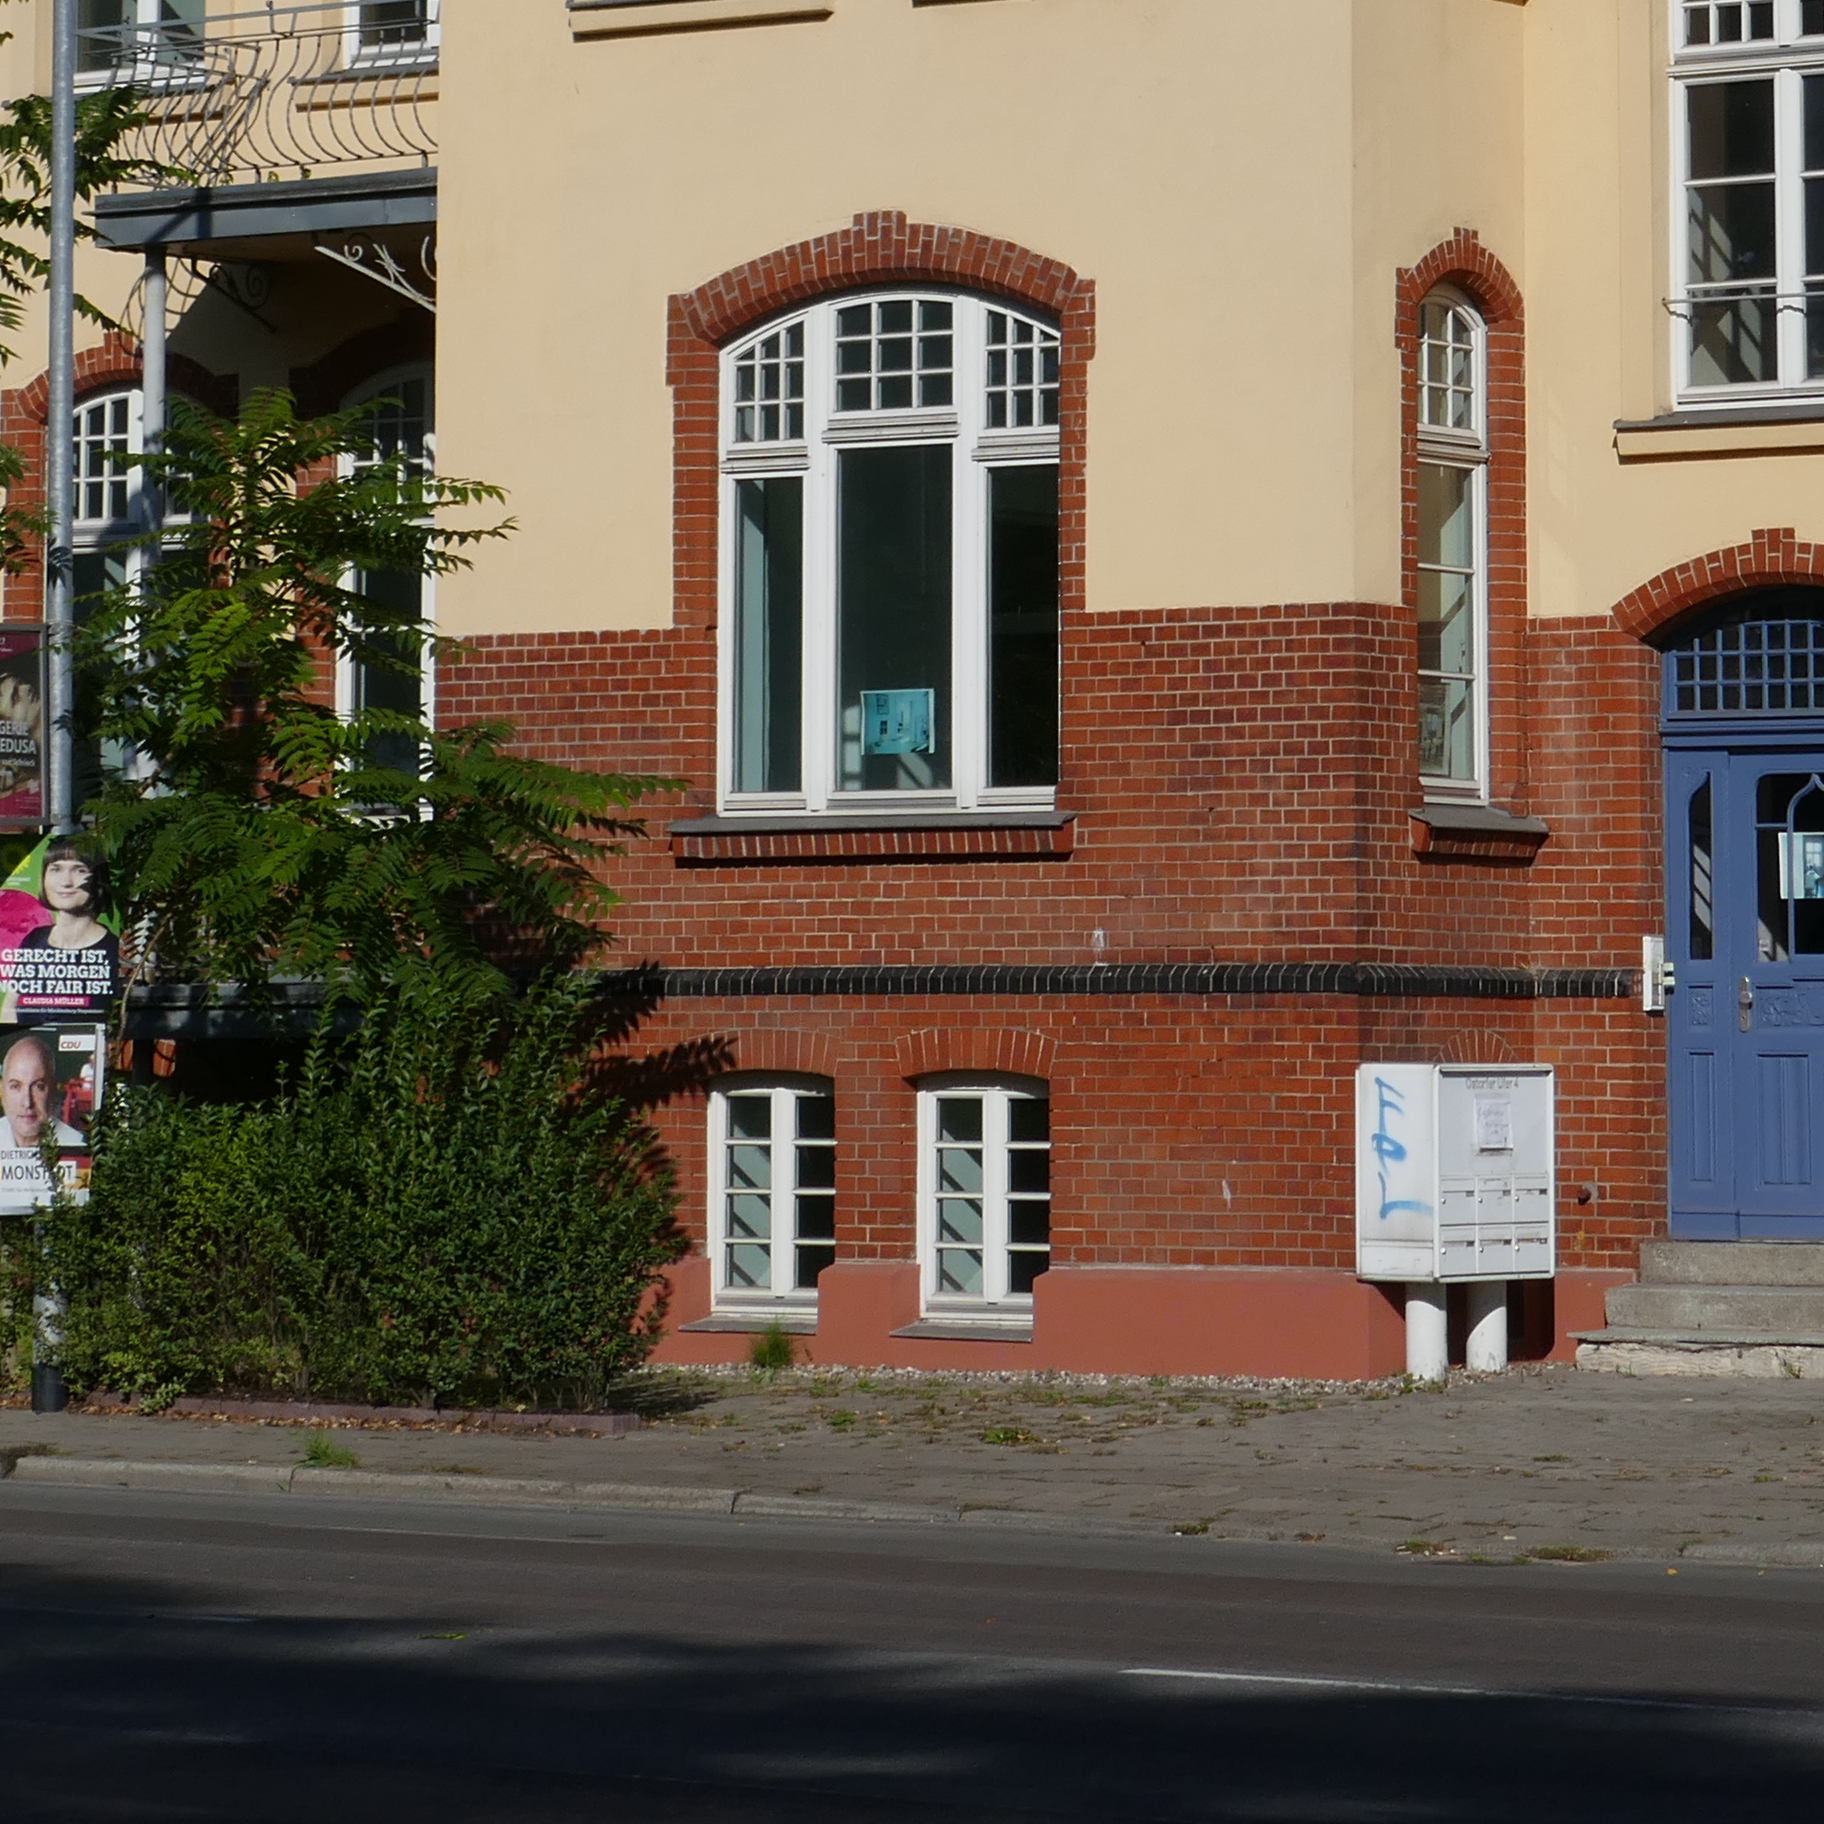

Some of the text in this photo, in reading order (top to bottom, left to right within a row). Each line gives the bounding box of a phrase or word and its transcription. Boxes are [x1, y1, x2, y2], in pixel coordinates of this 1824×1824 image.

[1, 949, 109, 965] GERECHT IST,
[0, 964, 111, 979] WAS MORGEN
[45, 980, 83, 994] FAIR
[85, 980, 113, 995] IST.
[22, 997, 84, 1005] CLAUDIA MÜLLER
[61, 1041, 81, 1049] CDU
